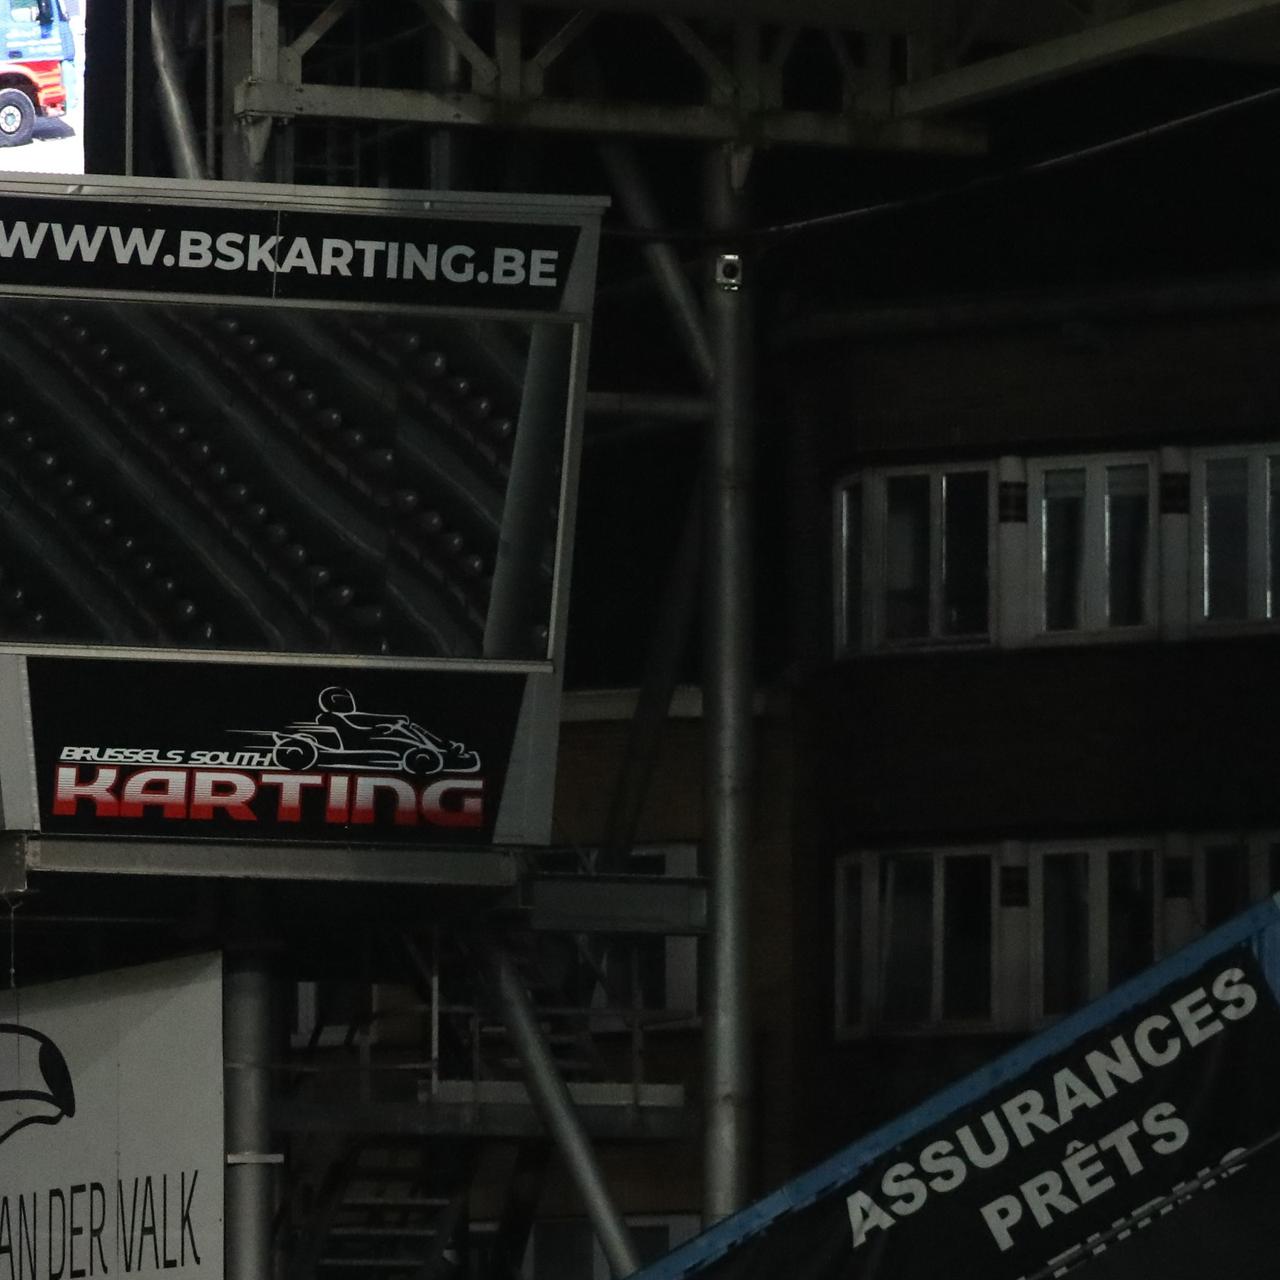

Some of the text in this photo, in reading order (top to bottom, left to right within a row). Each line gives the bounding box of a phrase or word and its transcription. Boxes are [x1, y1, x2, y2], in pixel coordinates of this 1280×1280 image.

[0, 220, 559, 287] WWW.BSKARTING.BE
[53, 765, 487, 829] KARTING
[59, 746, 274, 768] BRUSSELS SOUTH
[845, 967, 1259, 1249] ASSURANCES
[979, 1101, 1190, 1252] PRÊTS
[118, 1170, 200, 1273] VALK
